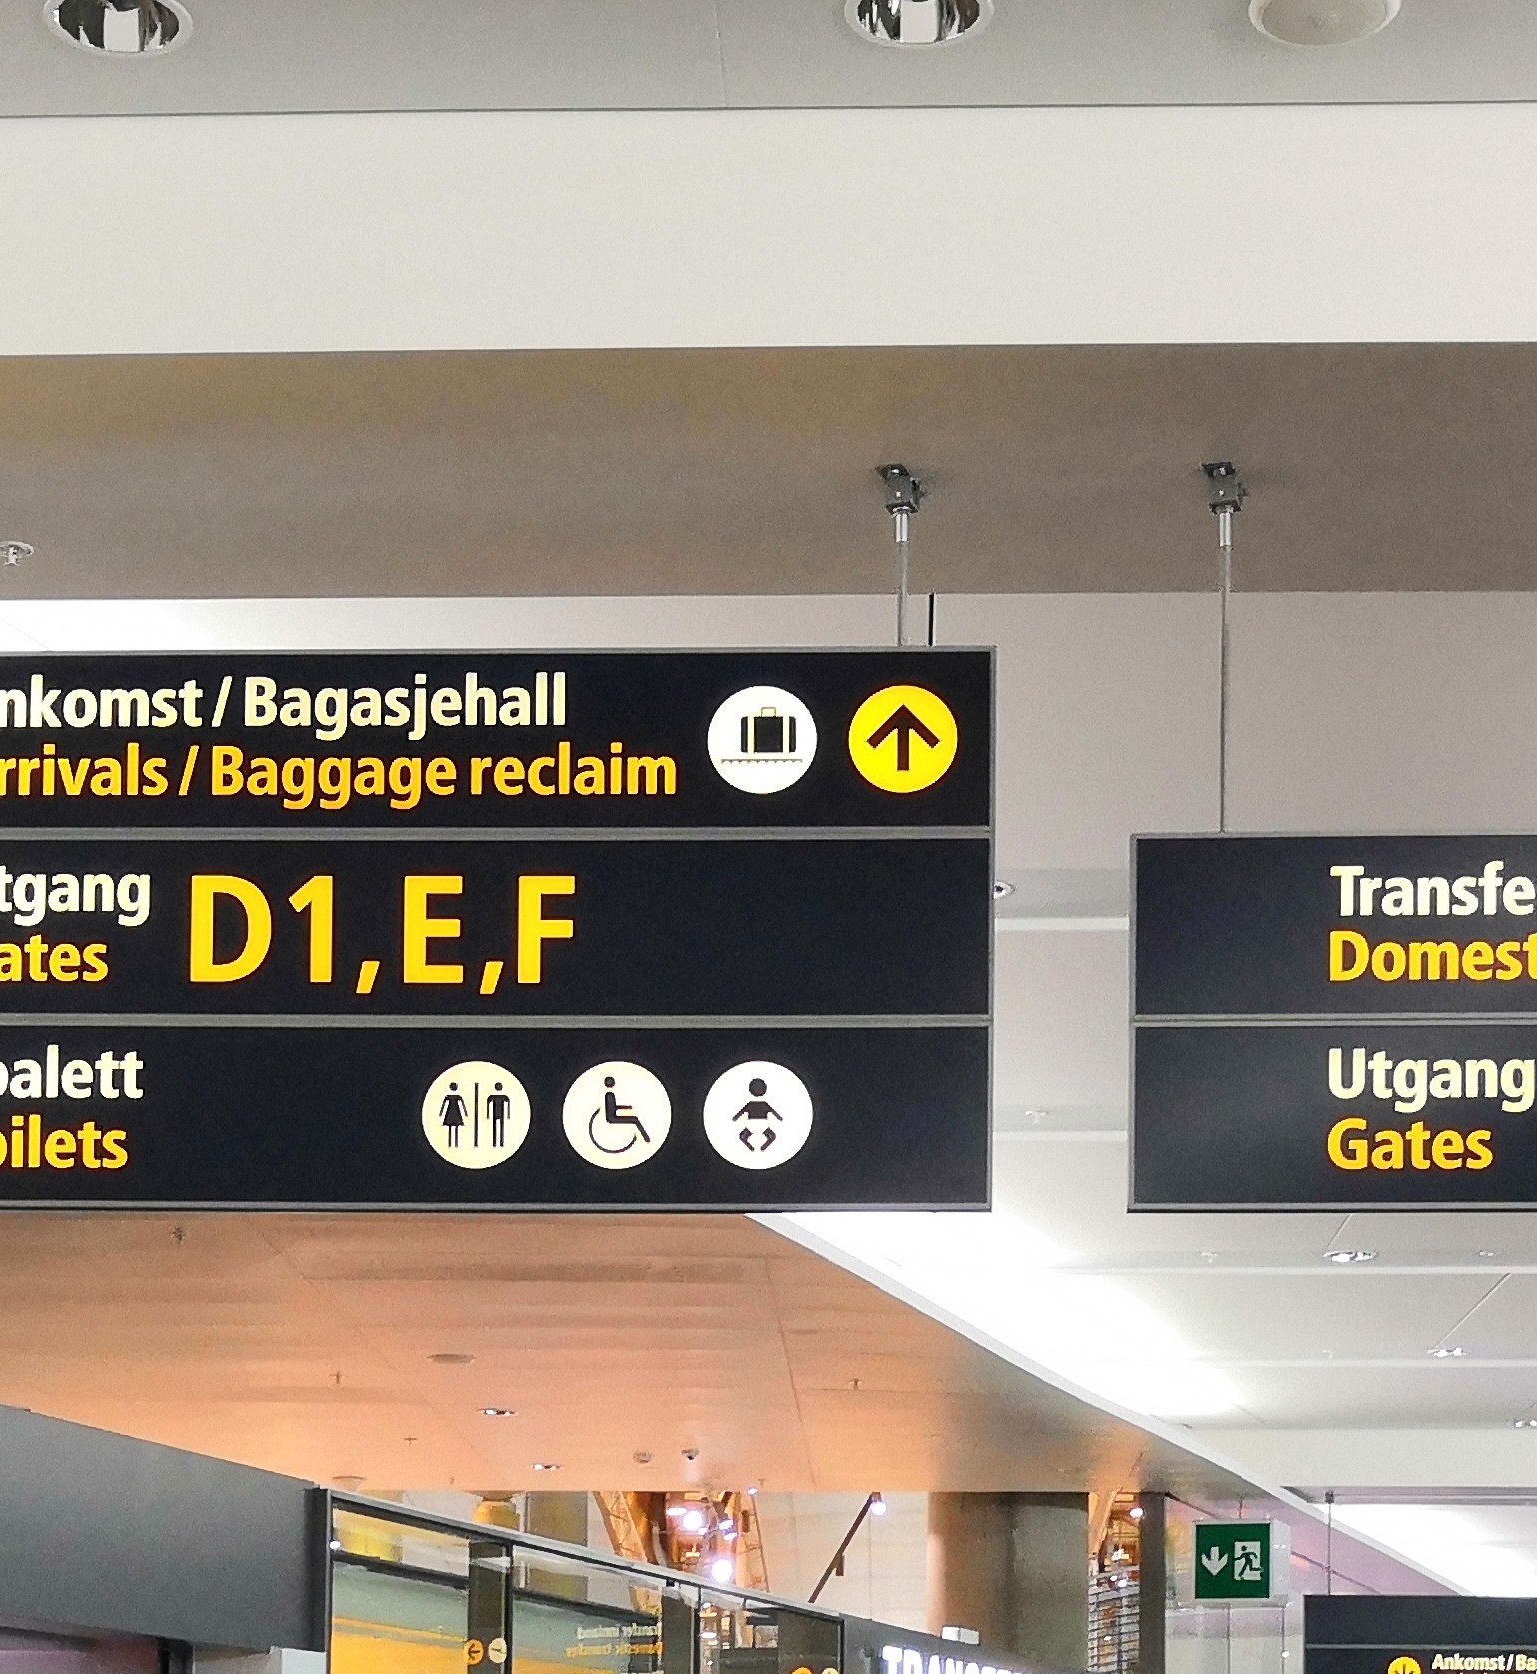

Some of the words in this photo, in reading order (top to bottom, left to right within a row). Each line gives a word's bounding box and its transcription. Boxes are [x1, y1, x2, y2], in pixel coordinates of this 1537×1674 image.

[245, 671, 566, 739] Bagasjehall
[211, 746, 457, 810] Baggage
[470, 741, 677, 796] reclaim
[1328, 1047, 1536, 1111] Utgang
[1327, 1117, 1494, 1170] Gates
[1431, 1653, 1505, 1671] Ankomst
